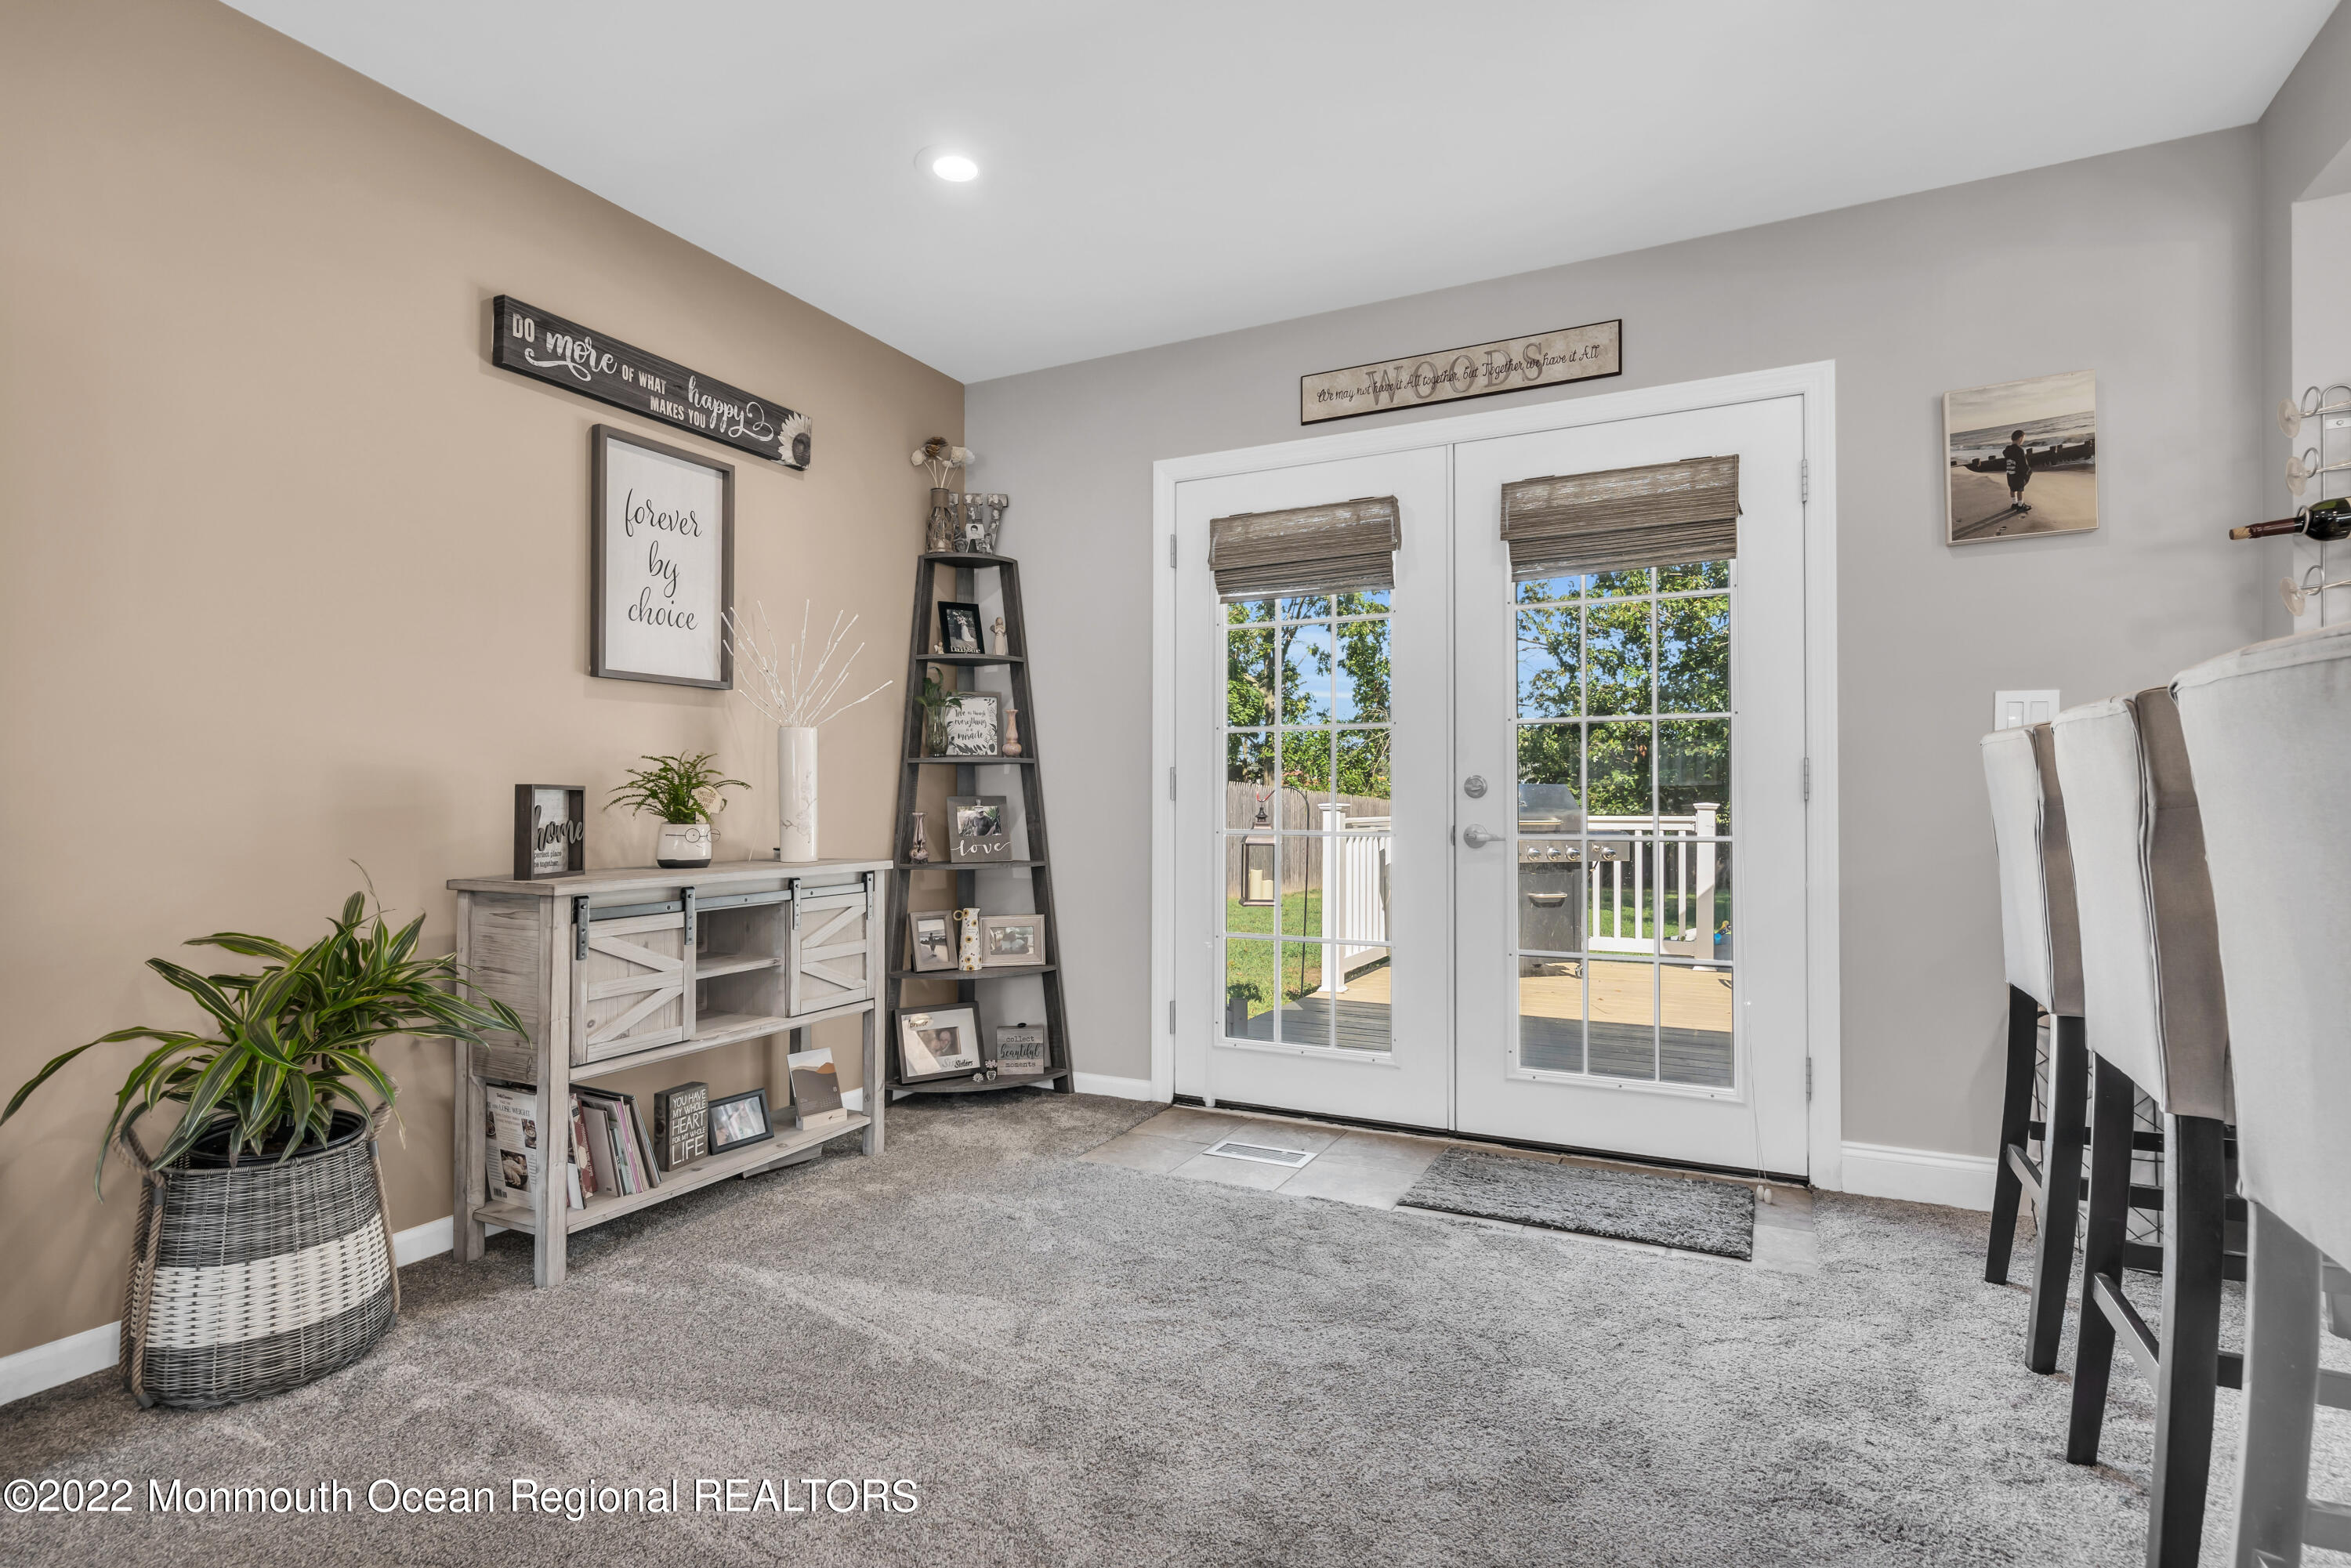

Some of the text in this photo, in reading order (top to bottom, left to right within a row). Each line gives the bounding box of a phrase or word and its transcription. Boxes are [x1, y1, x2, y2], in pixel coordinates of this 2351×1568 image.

[513, 313, 667, 395] DO more OF WHAT
[1317, 344, 1600, 402] We may not have it All together, but Together we have it All
[1365, 342, 1542, 406] WOODS
[650, 375, 774, 442] MAKES YOU happy
[625, 487, 703, 538] forever
[649, 540, 680, 599] by
[628, 586, 699, 630] choice
[955, 709, 965, 718] live
[955, 717, 987, 729] everything
[958, 730, 983, 741] miracle
[534, 805, 584, 852] home
[550, 850, 563, 859] place
[951, 839, 1011, 856] love
[1001, 1043, 1041, 1060] beautiful
[954, 1059, 973, 1069] Sisters
[672, 1088, 707, 1109] YOU HAVE
[672, 1099, 706, 1119] MY WHOLE
[511, 1106, 531, 1117] WEIGHT
[672, 1109, 706, 1136] HEART
[672, 1126, 705, 1144] FOR MY WHOLE
[672, 1135, 705, 1165] LIFE
